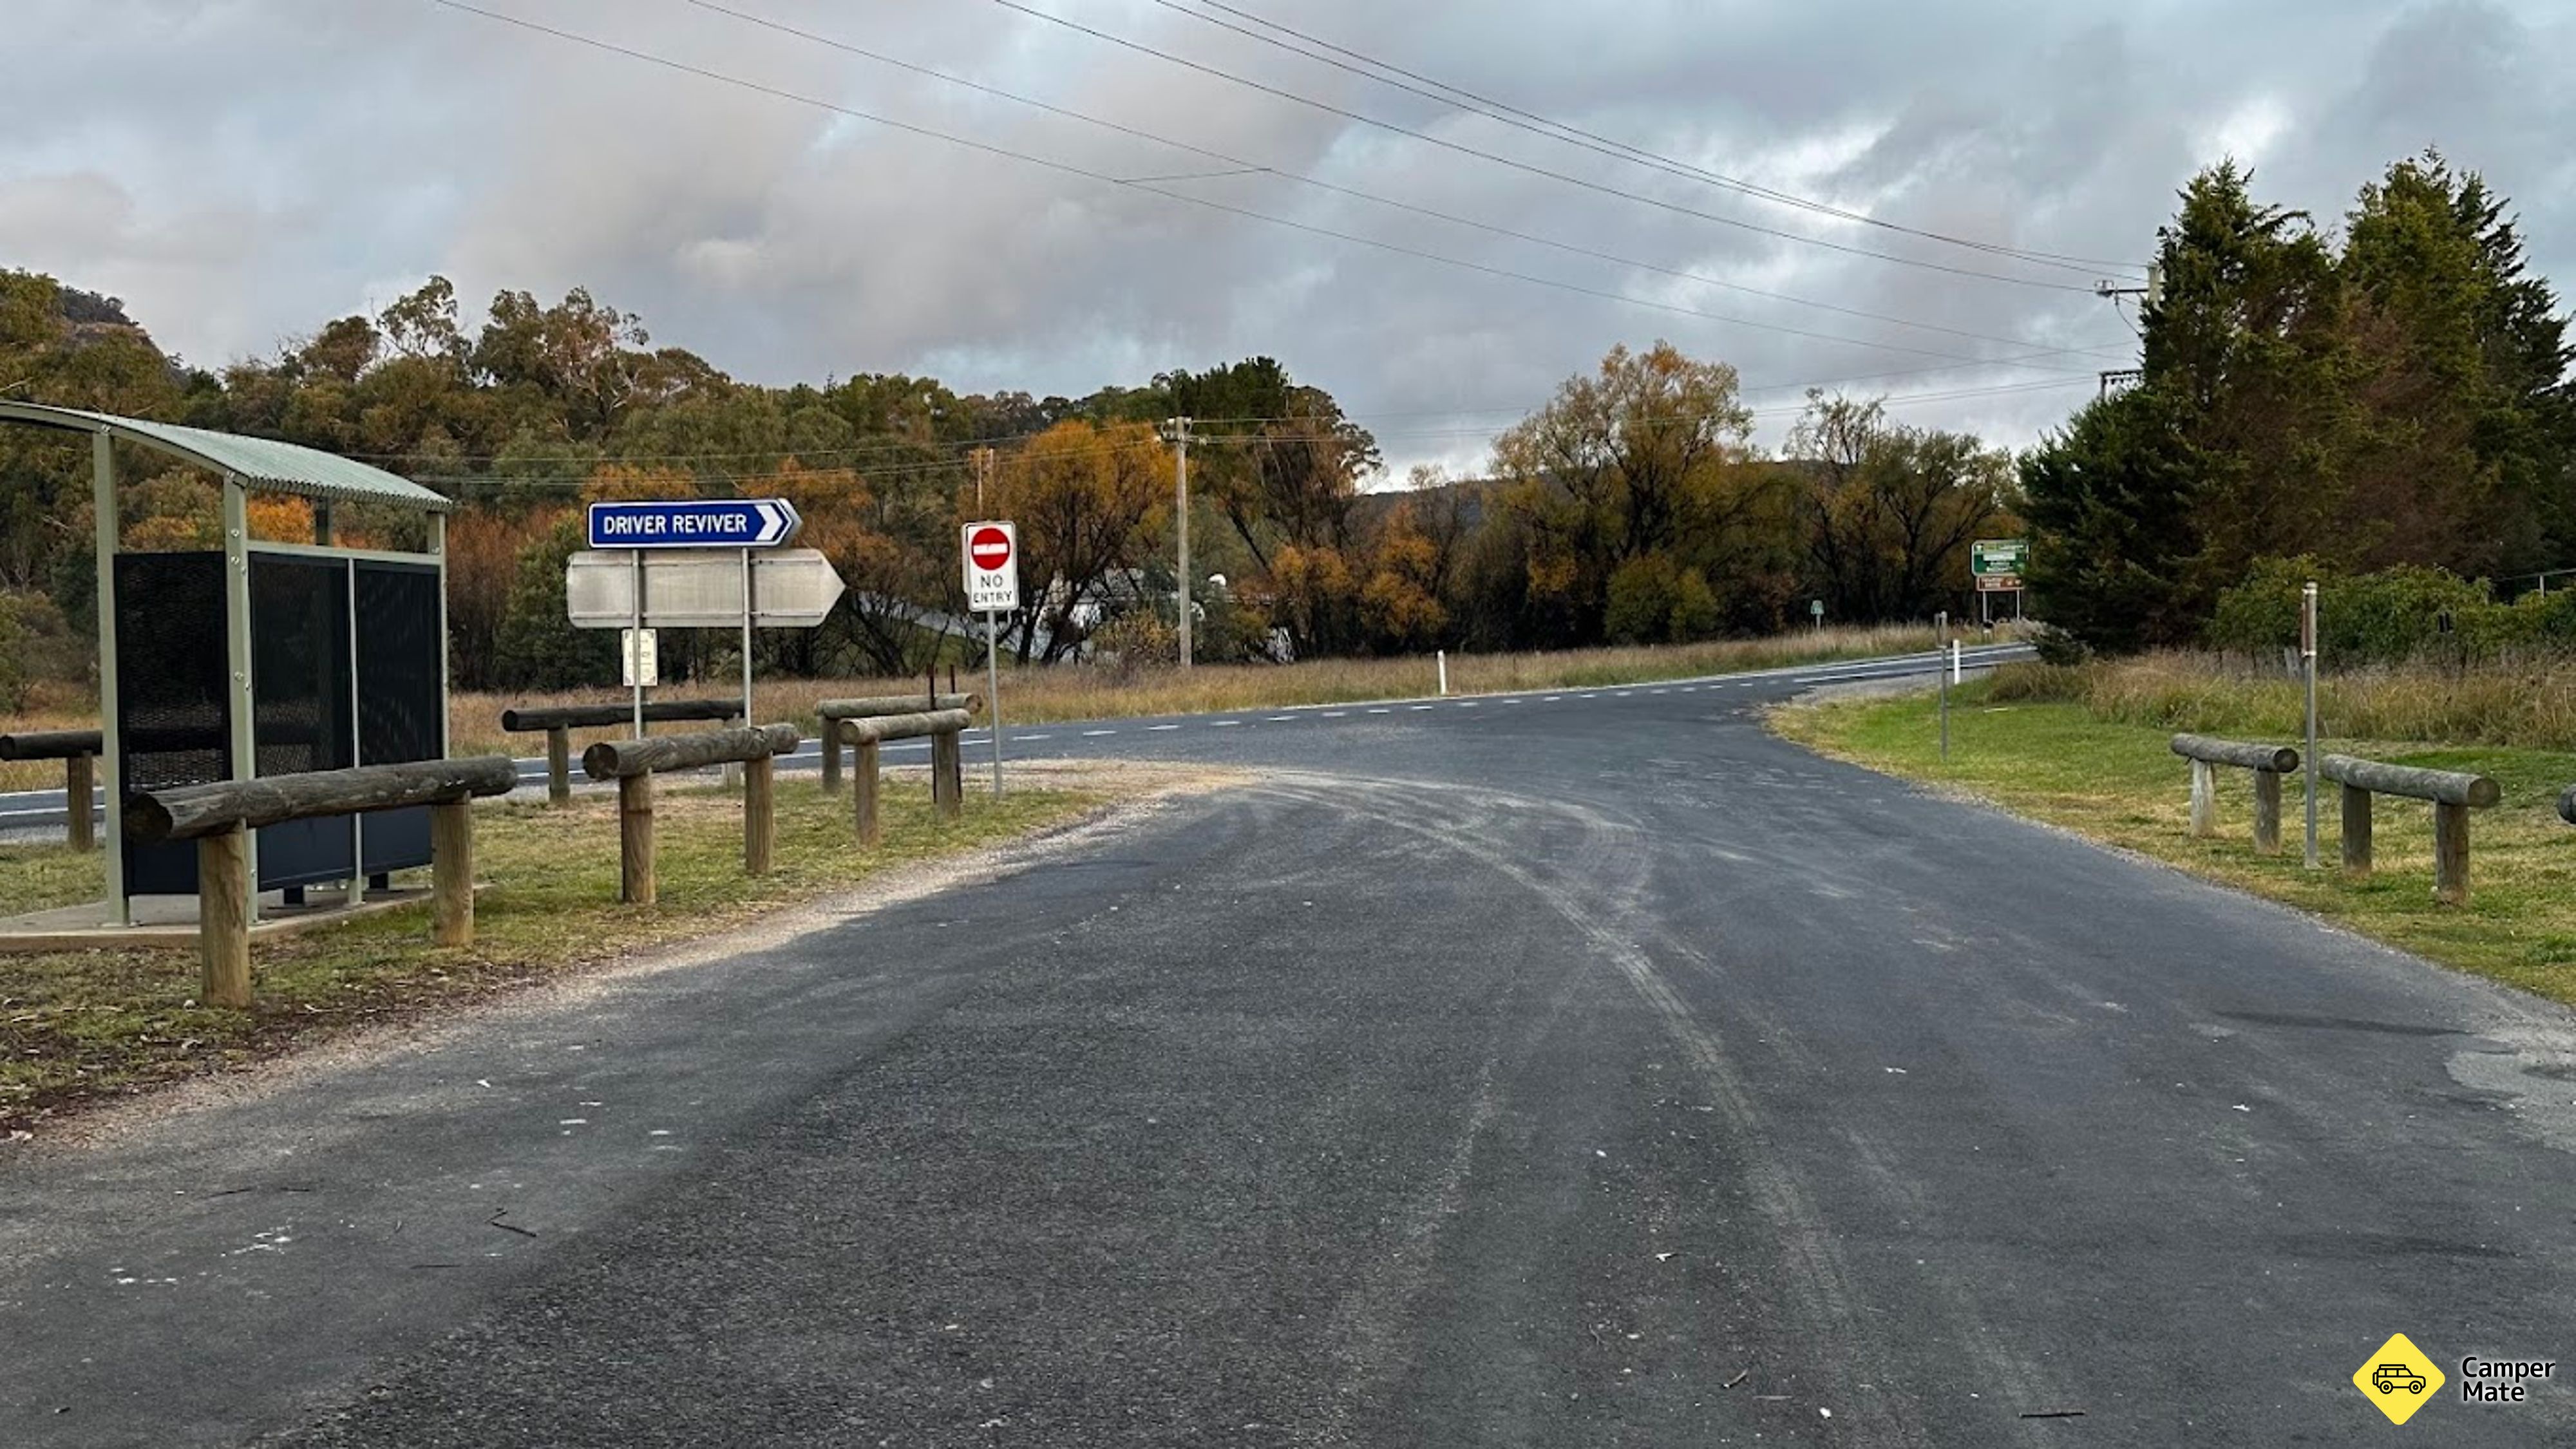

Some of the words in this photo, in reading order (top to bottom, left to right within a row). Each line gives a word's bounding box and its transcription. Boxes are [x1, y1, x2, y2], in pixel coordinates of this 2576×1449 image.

[603, 515, 666, 535] DRIVER
[672, 513, 747, 534] REVIVER
[980, 574, 1003, 588] NO
[973, 590, 1012, 603] ENTRY
